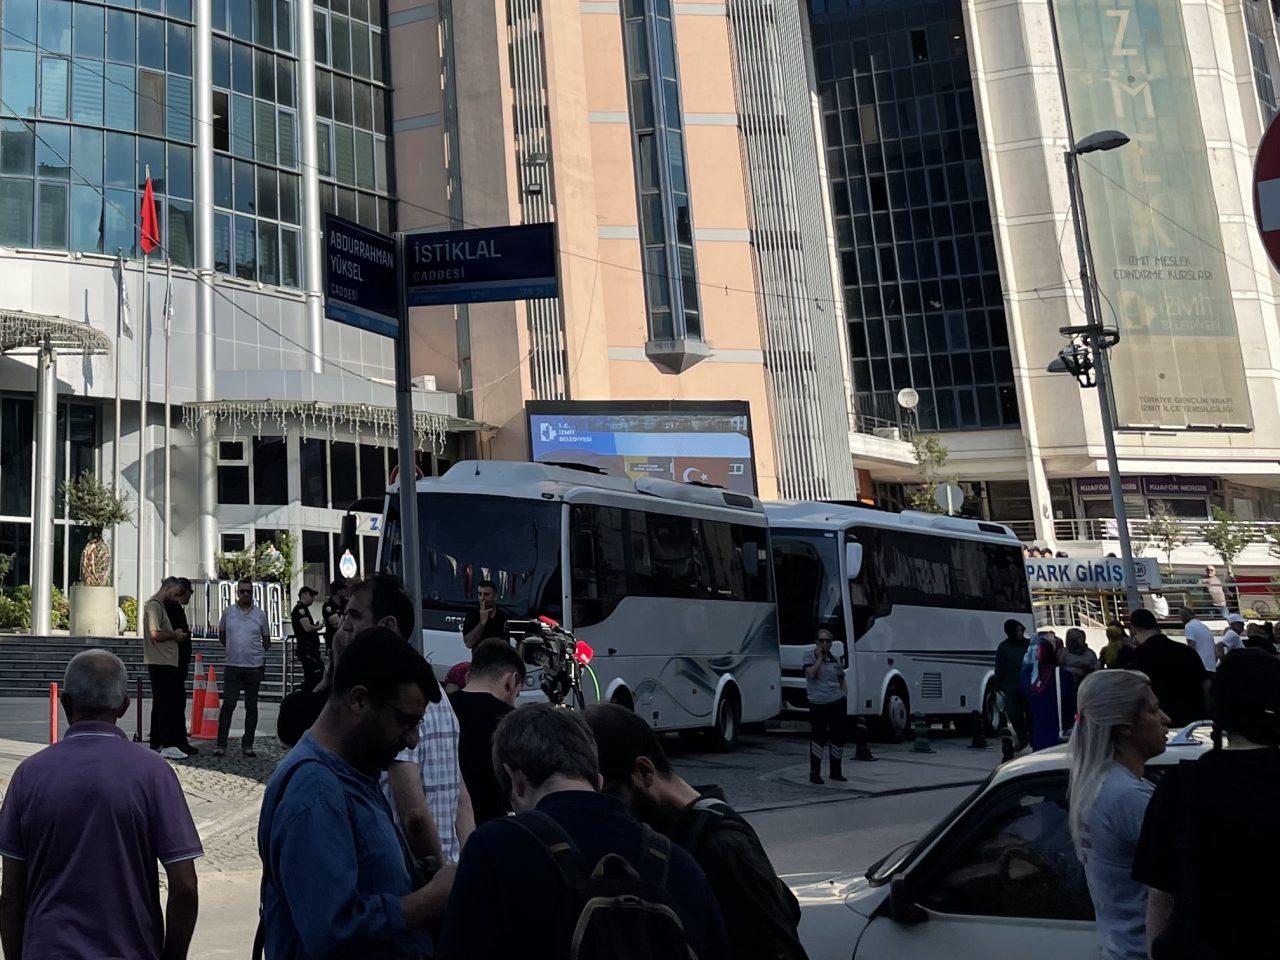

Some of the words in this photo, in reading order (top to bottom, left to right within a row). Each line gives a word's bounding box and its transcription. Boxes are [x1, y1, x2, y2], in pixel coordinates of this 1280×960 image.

[330, 230, 394, 269] ABDURRAHMAN
[414, 239, 502, 264] İSTİKLAL
[330, 255, 364, 282] YÜKSEL
[413, 266, 465, 282] CADDESİ
